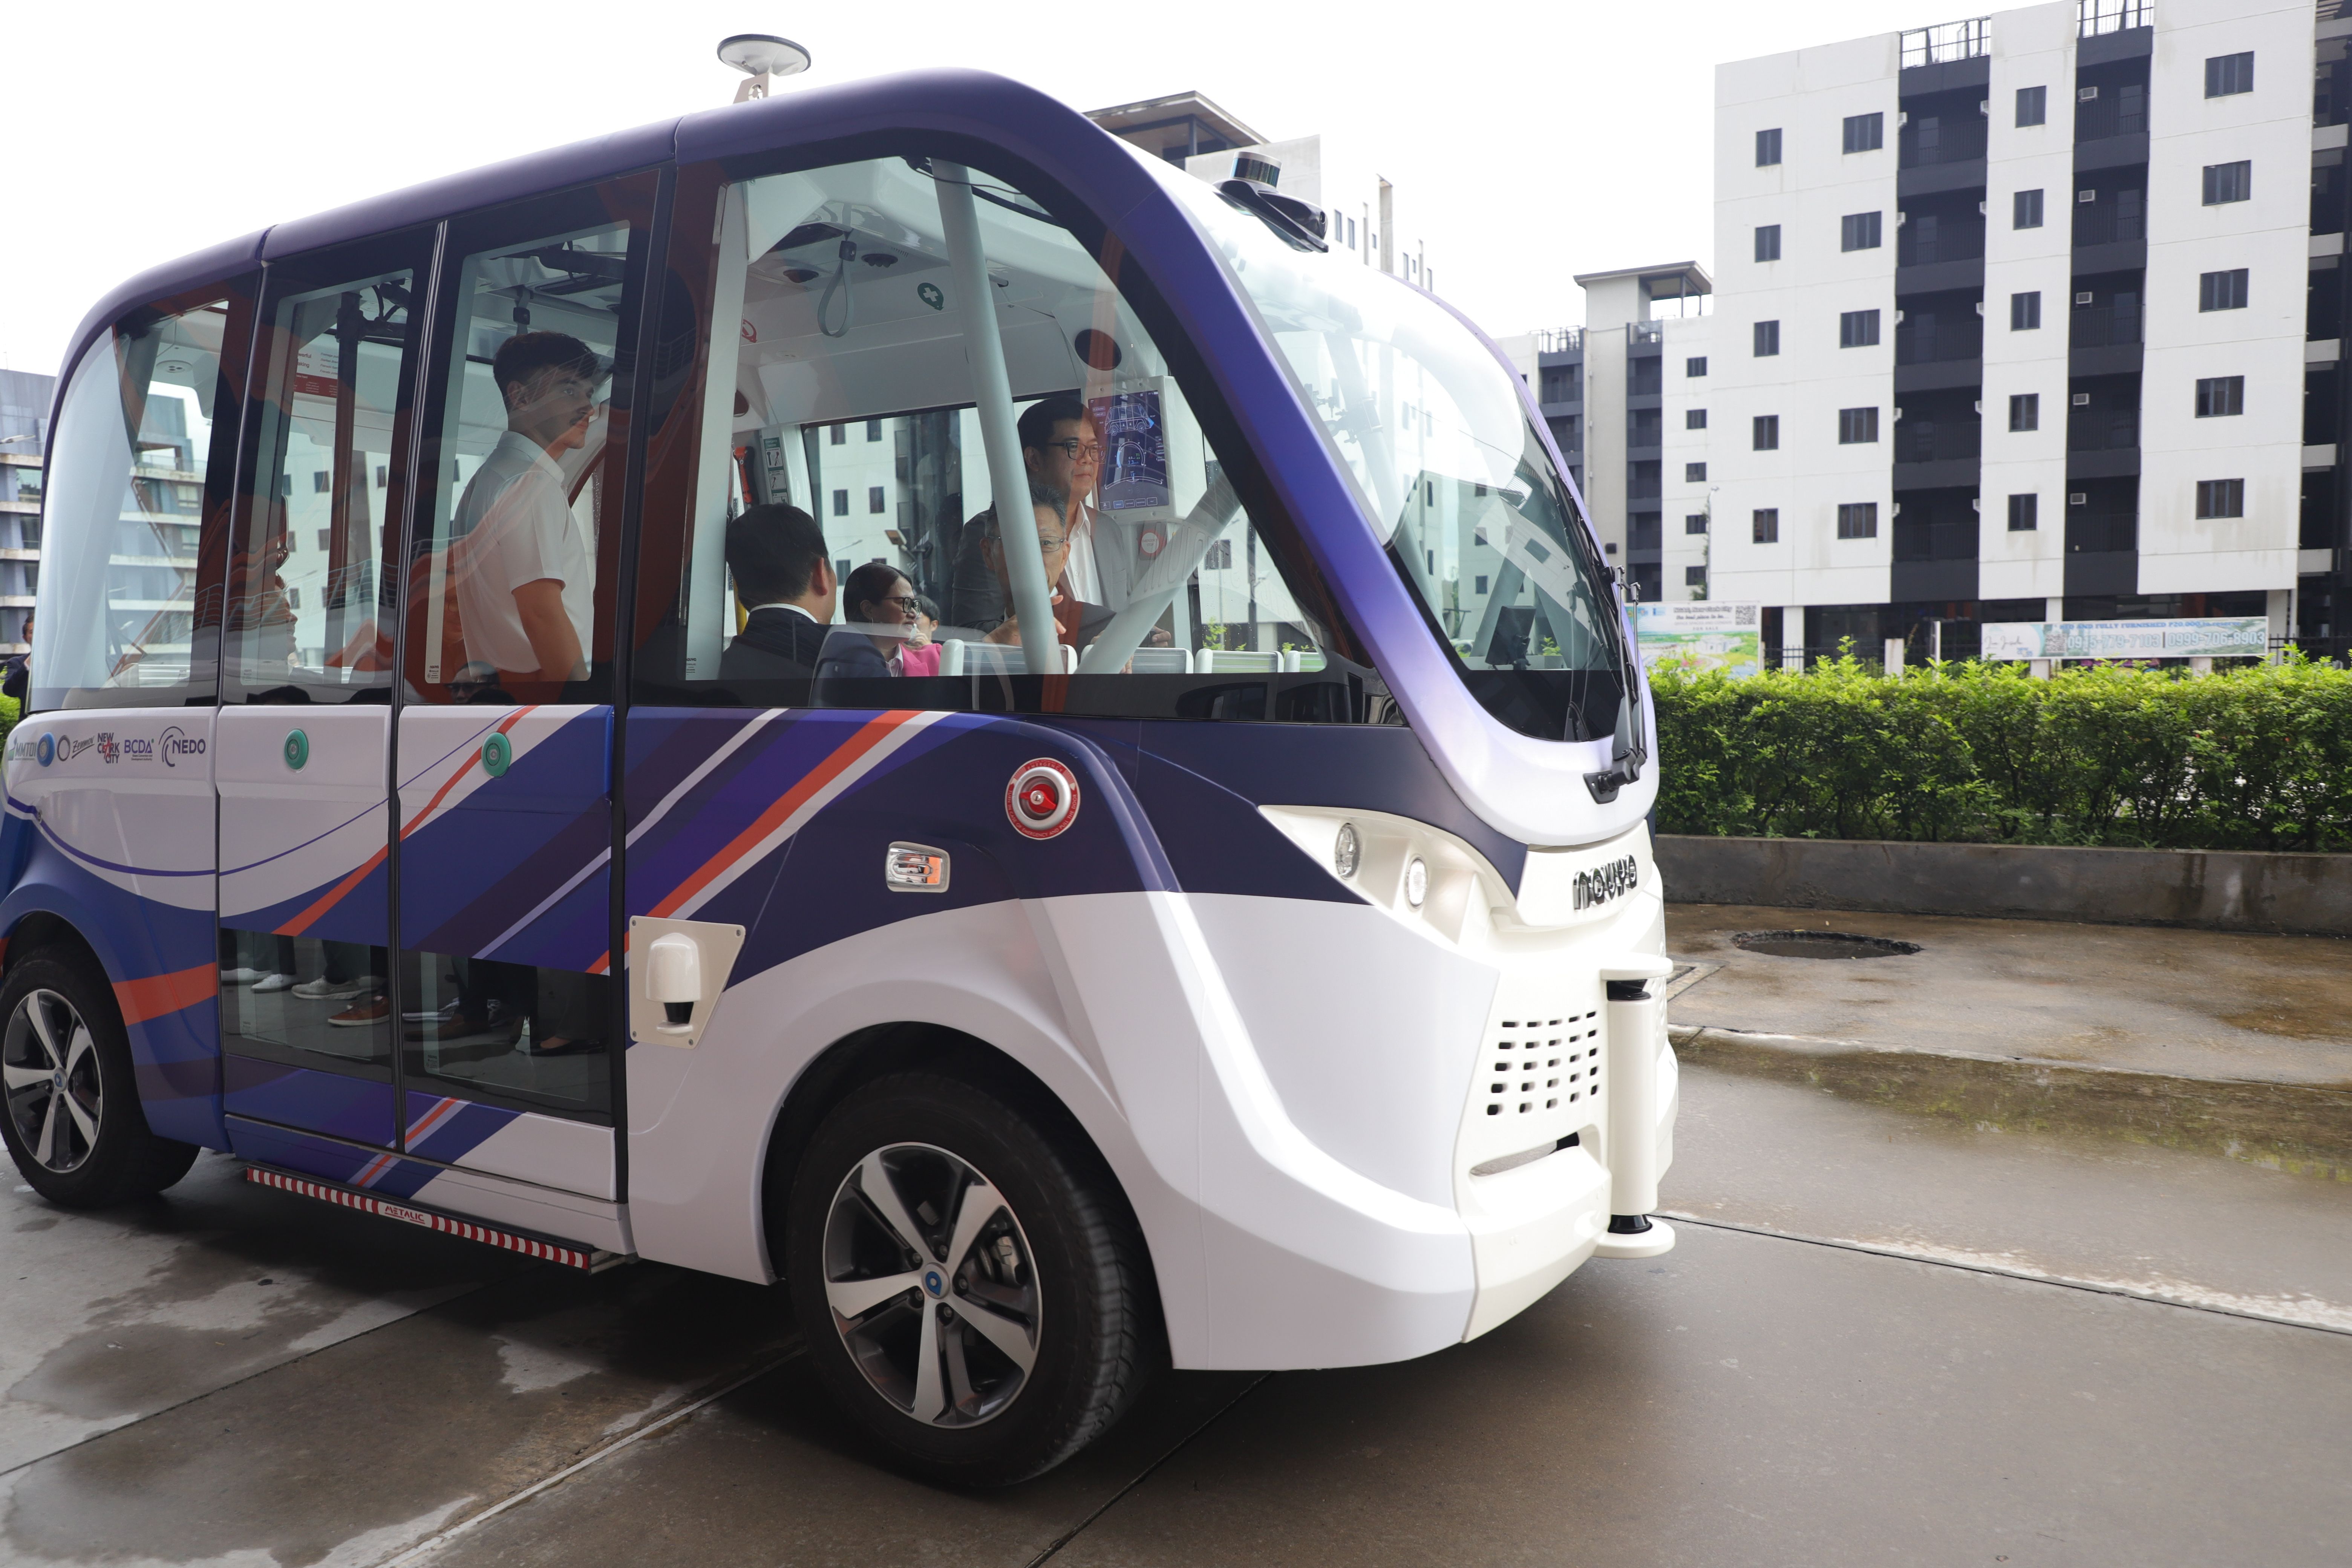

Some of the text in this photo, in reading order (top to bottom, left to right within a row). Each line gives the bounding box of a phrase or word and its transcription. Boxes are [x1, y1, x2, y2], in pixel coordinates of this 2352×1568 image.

[2168, 631, 2265, 646] 0999-706-8903
[97, 732, 114, 742] NEW
[124, 739, 153, 754] BCDA
[172, 738, 206, 754] NEDO
[105, 753, 120, 764] CITY
[1027, 762, 1063, 773] EMERGENCY
[1021, 828, 1048, 837] EMERGENCY
[384, 1205, 425, 1222] METALIC
